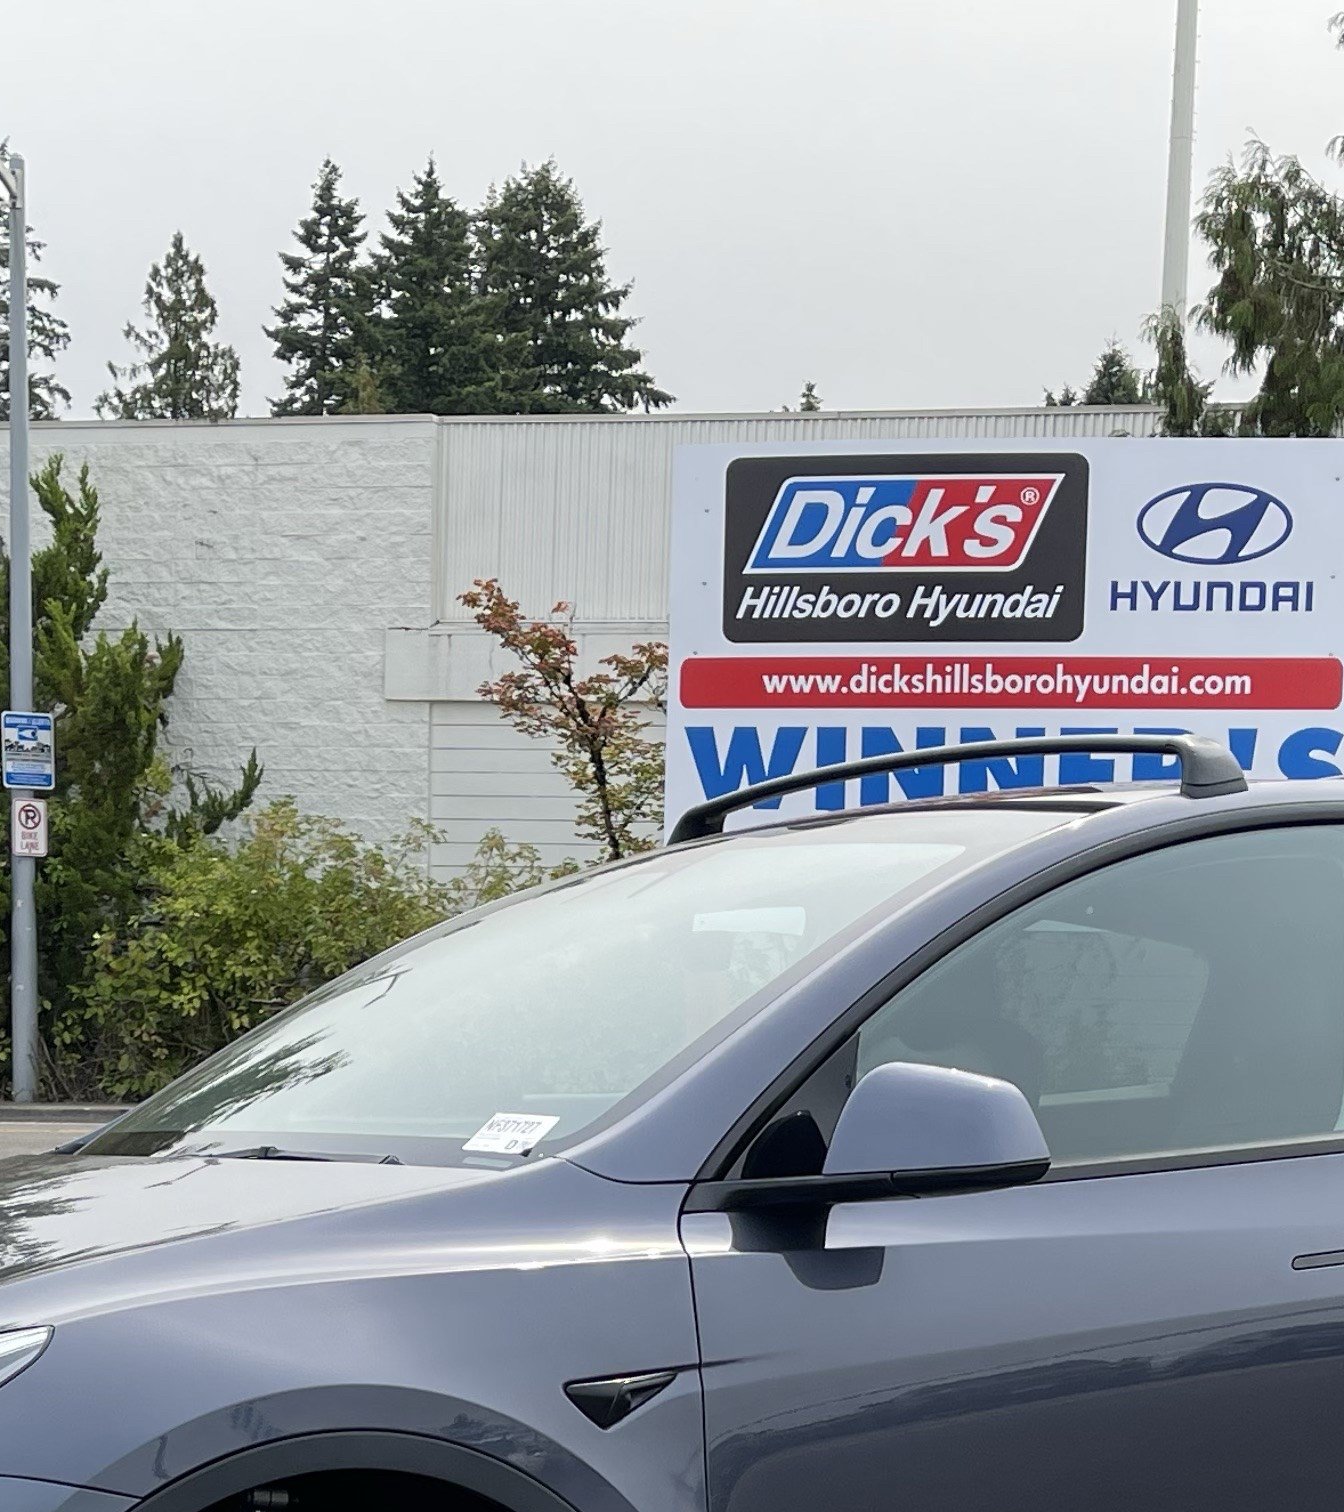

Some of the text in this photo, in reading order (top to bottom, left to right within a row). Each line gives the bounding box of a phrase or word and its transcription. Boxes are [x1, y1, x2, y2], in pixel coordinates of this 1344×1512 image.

[735, 584, 1065, 628] Hillsboro Hyundai
[1109, 580, 1314, 613] HYUNDAI
[762, 663, 1252, 703] www.dickshillsborohyundai.com
